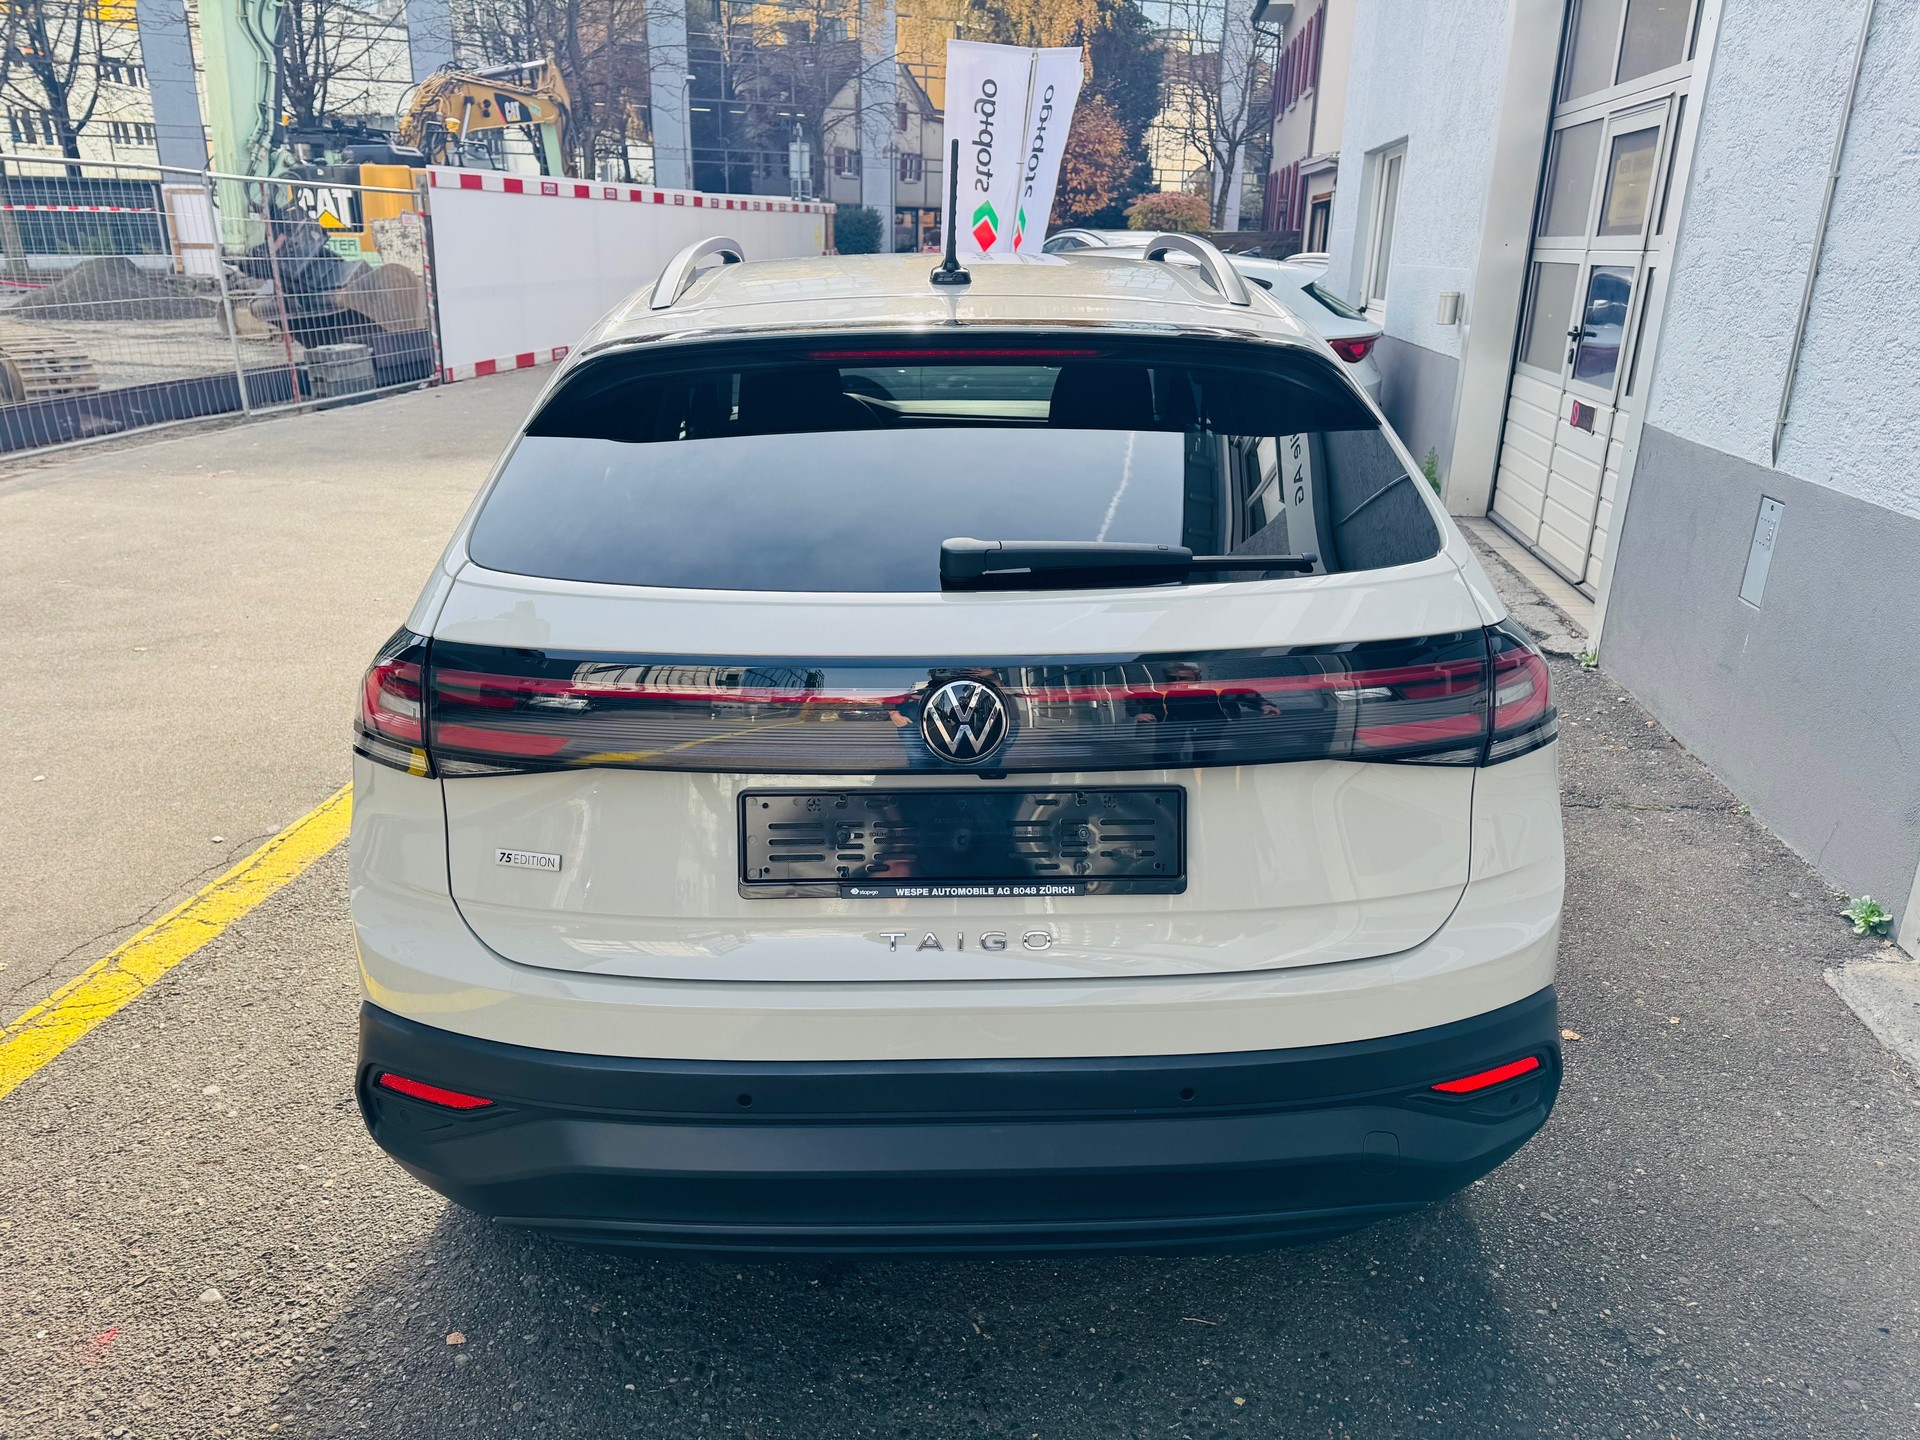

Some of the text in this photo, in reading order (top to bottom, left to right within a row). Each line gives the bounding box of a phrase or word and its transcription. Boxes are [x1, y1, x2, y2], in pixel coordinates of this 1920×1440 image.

[503, 101, 521, 122] CAT
[298, 187, 353, 229] CAT
[896, 885, 1075, 896] WESPE AUTOMOBILE AG 8048 ZÜRICH
[879, 931, 1052, 952] TAIGO
